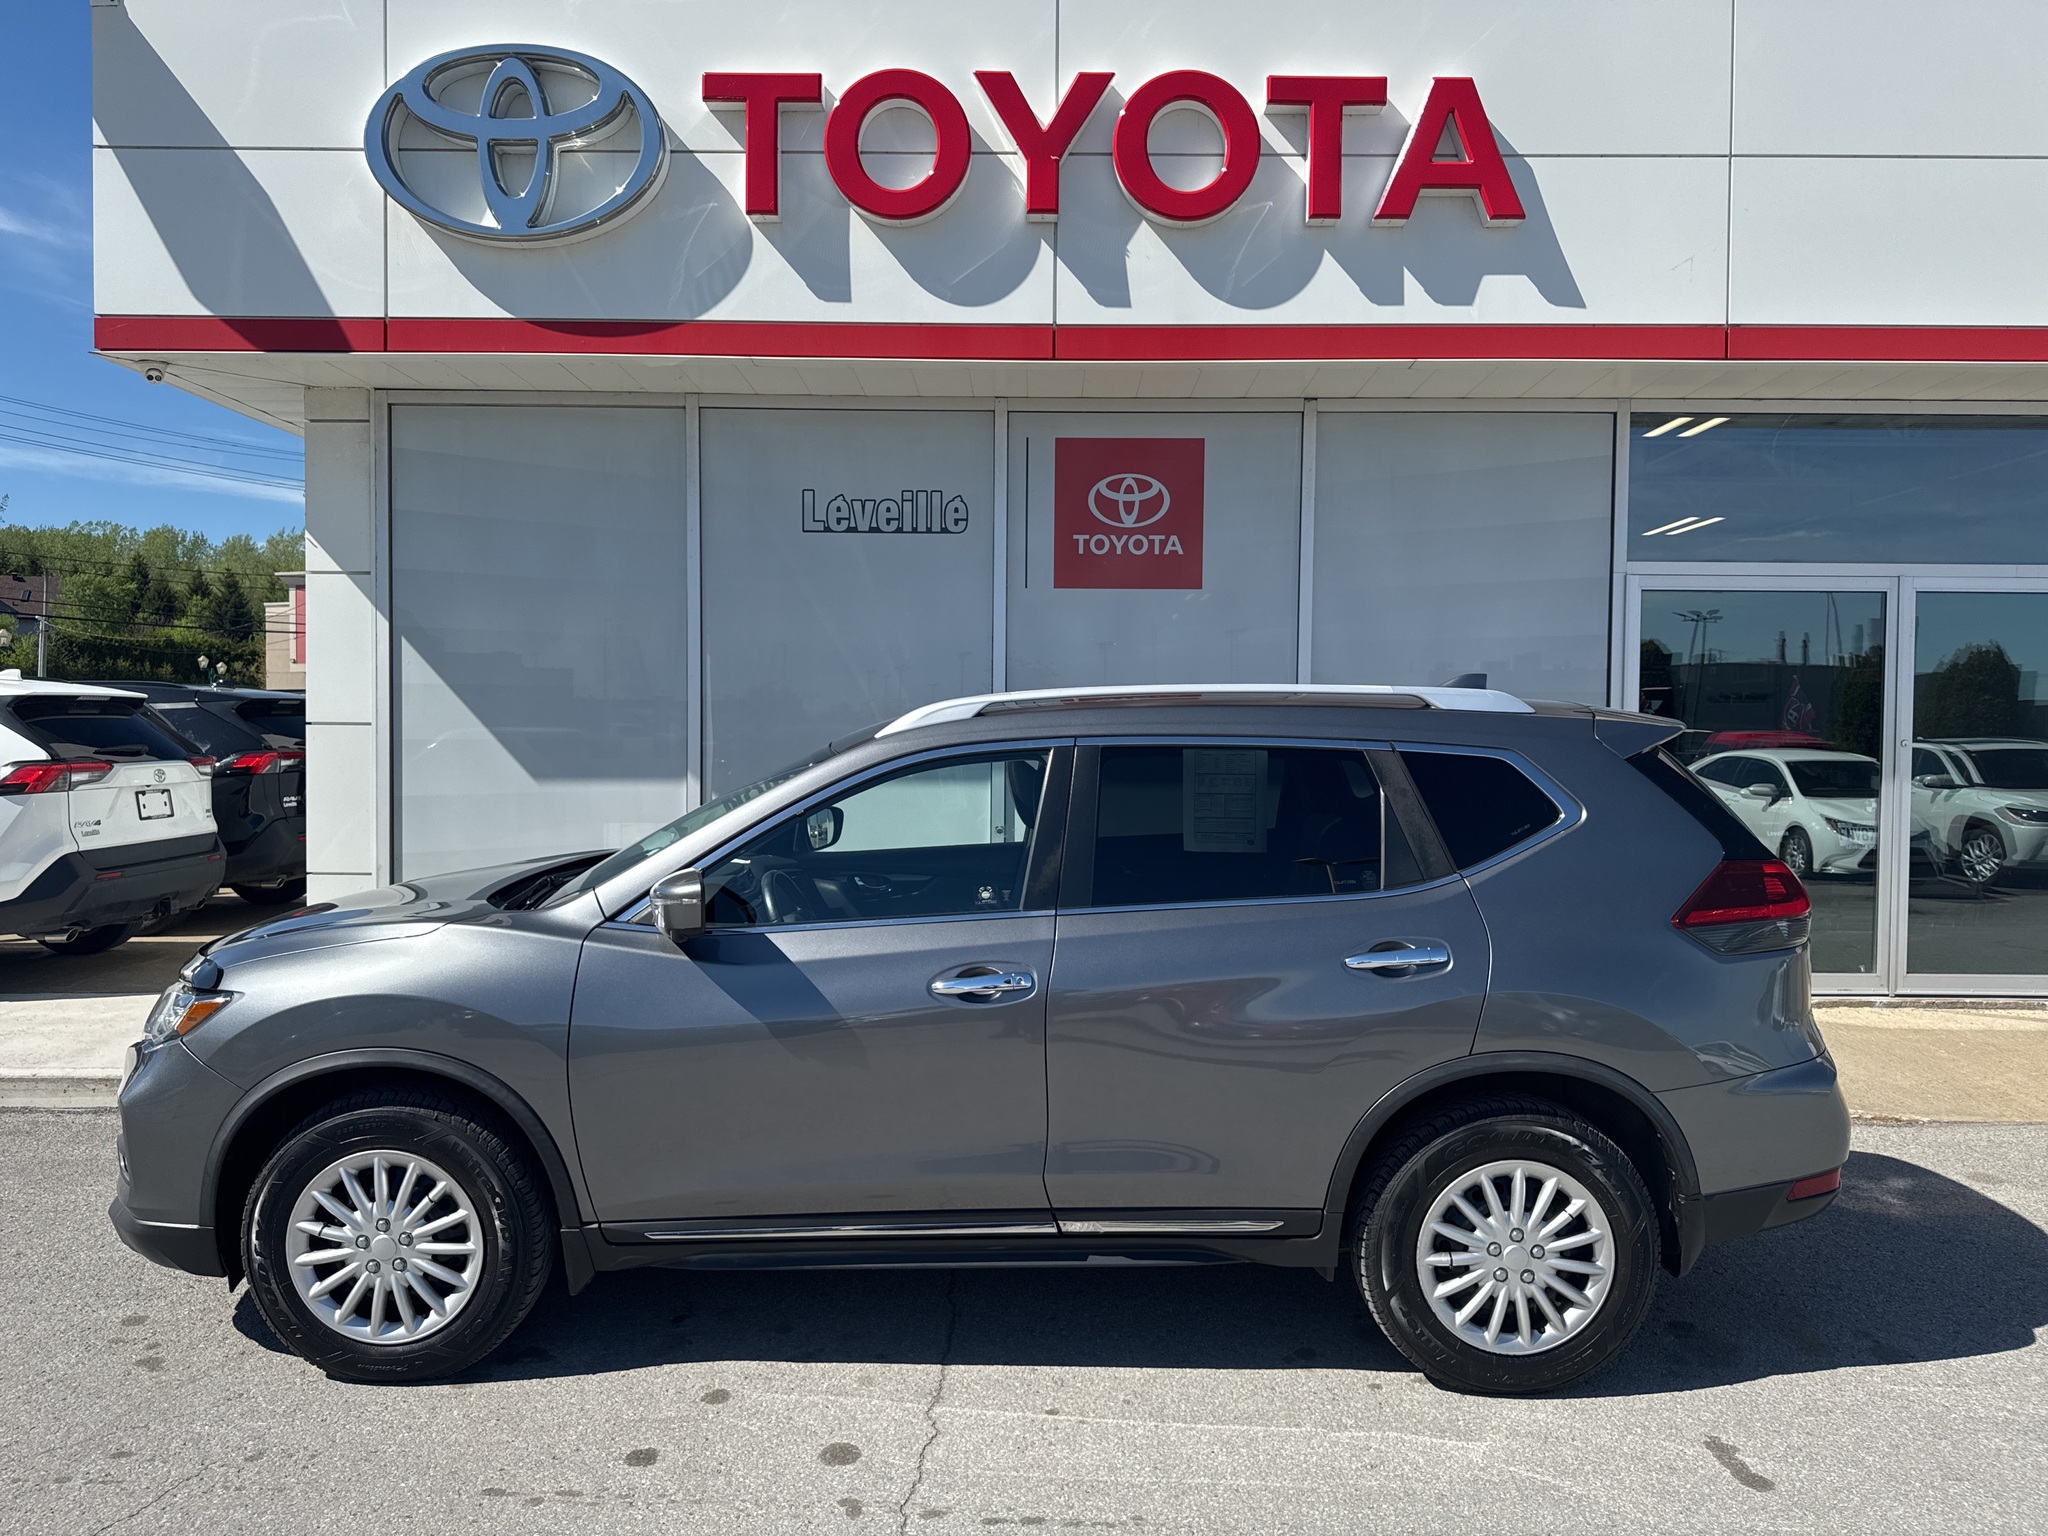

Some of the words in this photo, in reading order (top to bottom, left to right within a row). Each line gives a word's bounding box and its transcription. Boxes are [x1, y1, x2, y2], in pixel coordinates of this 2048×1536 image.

[702, 68, 1526, 227] TOYOTA
[802, 488, 969, 534] Léveillé
[1073, 534, 1184, 556] TOYOTA
[74, 819, 102, 829] RAV4
